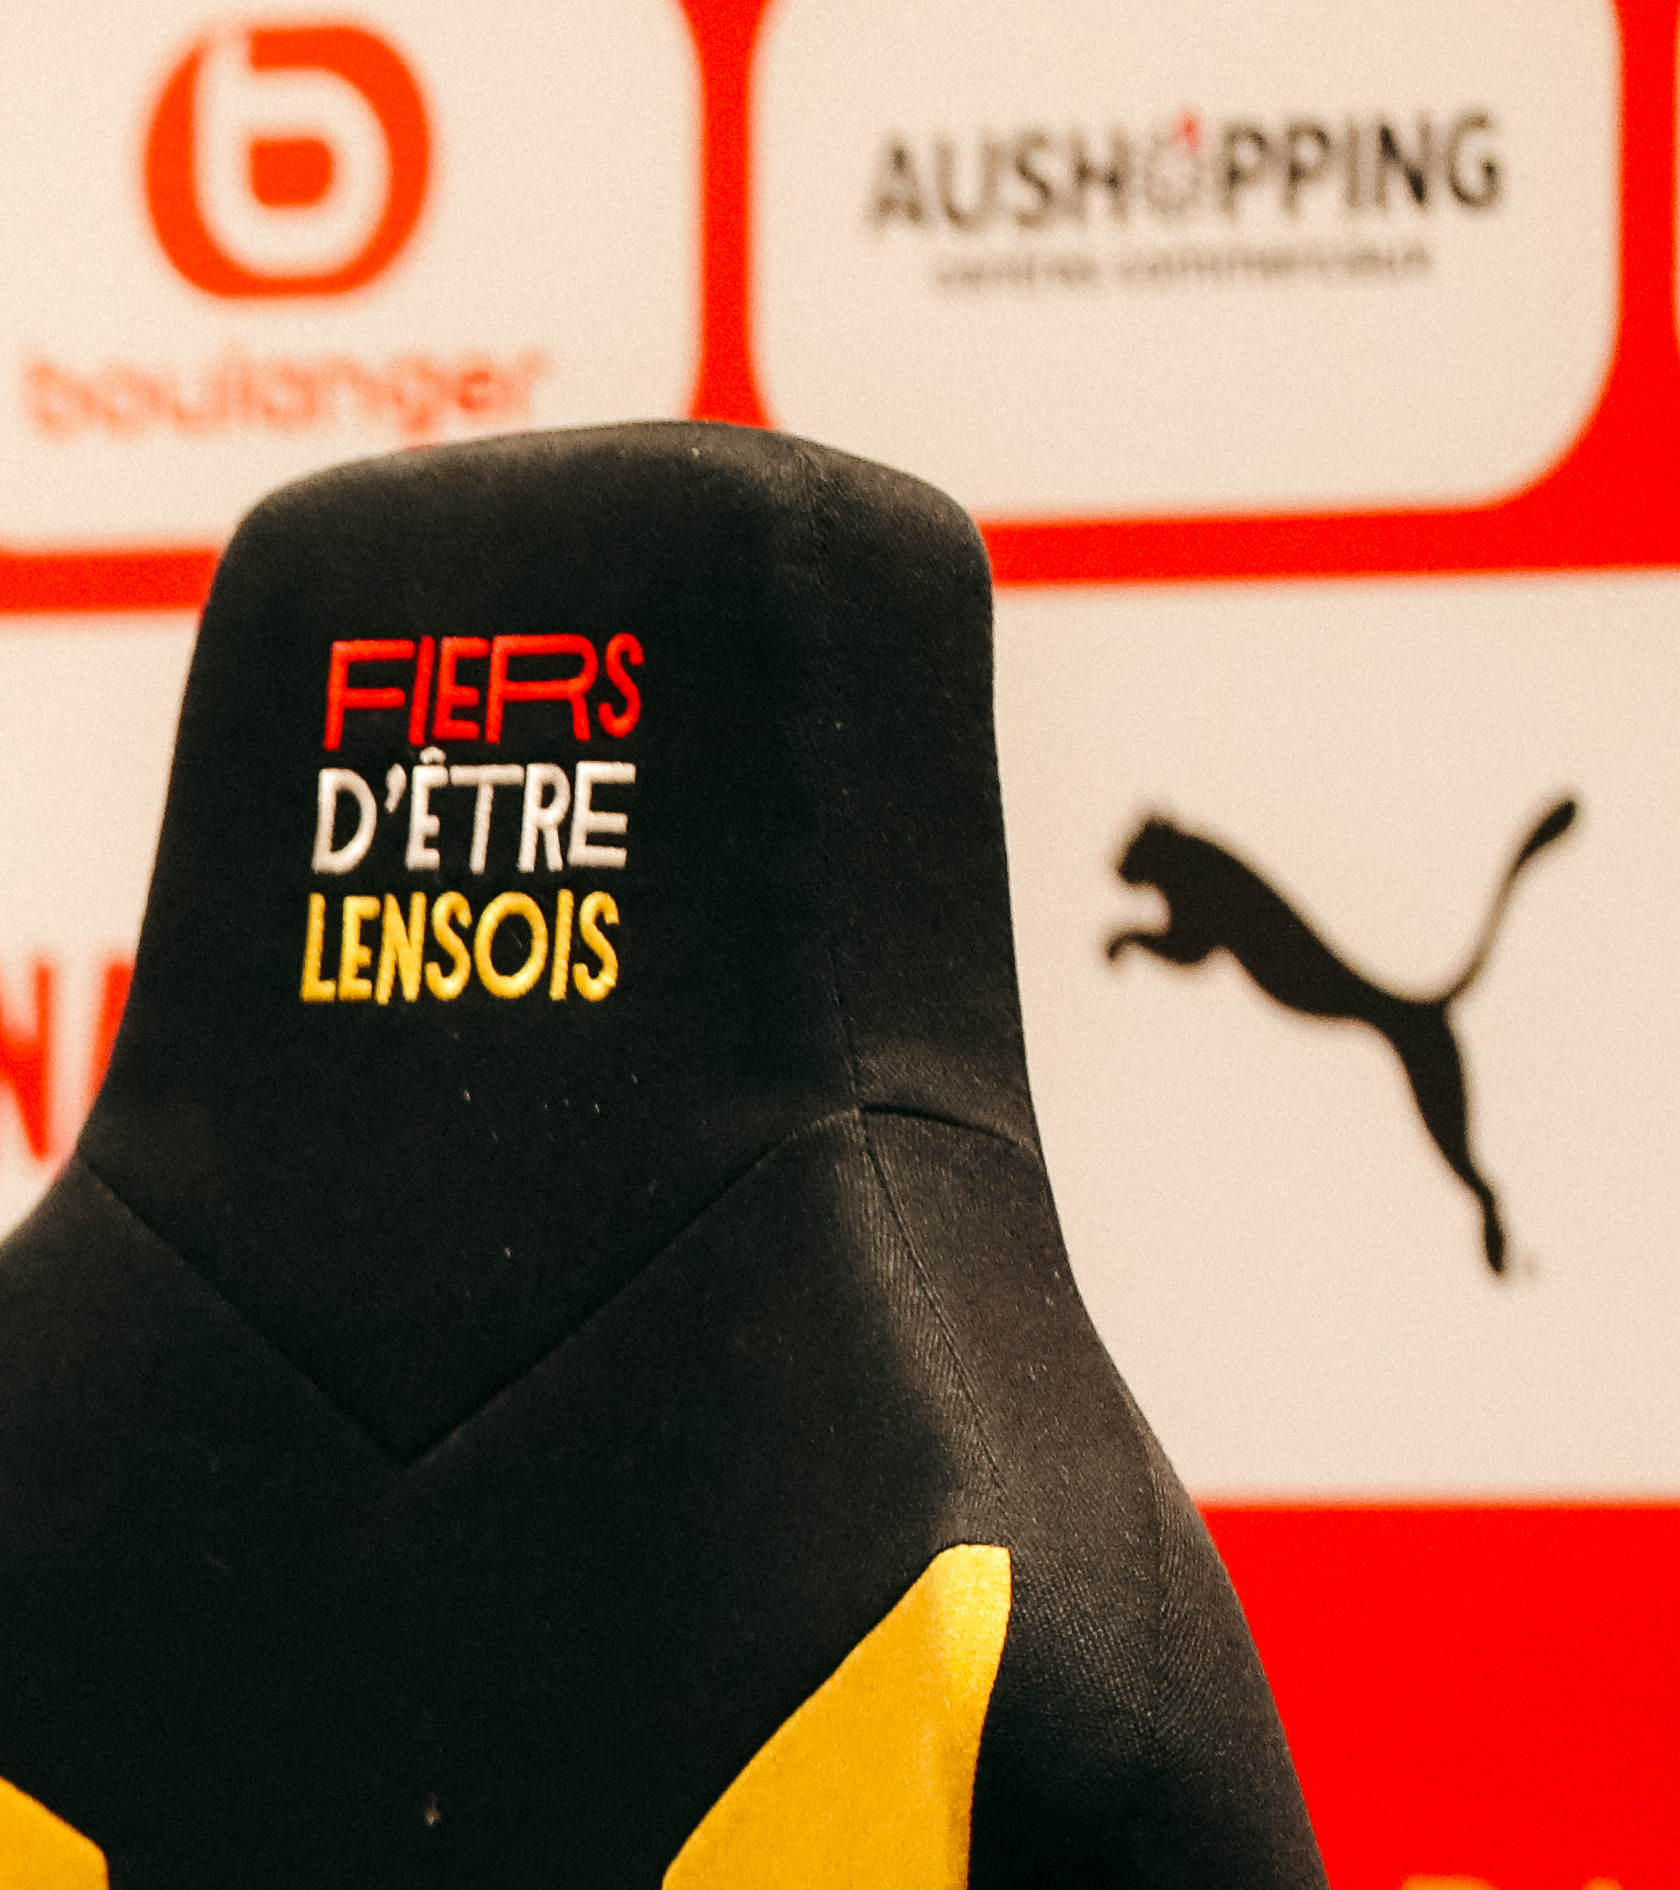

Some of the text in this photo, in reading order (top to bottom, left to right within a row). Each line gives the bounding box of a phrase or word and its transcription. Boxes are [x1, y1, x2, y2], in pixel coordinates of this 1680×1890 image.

[865, 108, 1505, 234] AUSHOPPING
[324, 632, 644, 750] FIERS
[312, 746, 637, 874] D'ÊTRE
[300, 888, 620, 1004] LENSOIS
